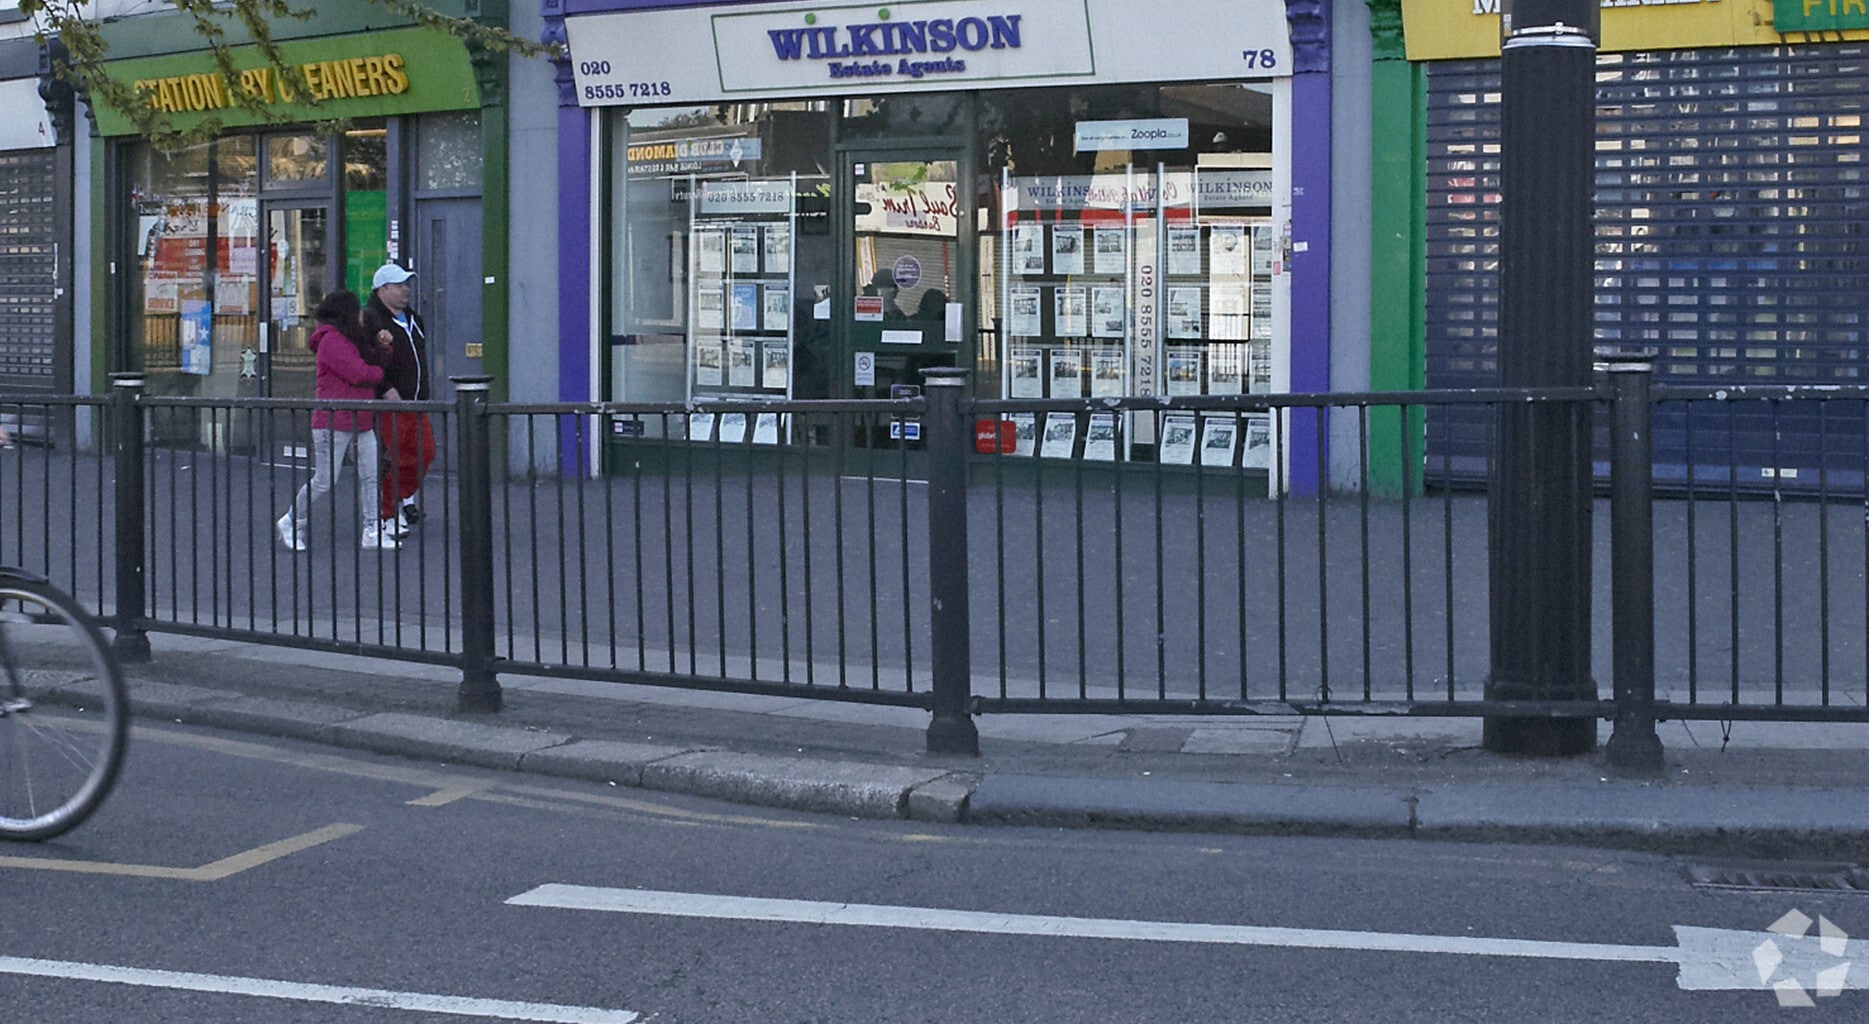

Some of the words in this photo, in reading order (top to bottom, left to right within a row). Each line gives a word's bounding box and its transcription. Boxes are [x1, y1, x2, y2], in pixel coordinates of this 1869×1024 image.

[767, 14, 1022, 61] WILKINSON
[580, 60, 611, 76] 020
[828, 60, 892, 78] Estate
[897, 56, 966, 78] Agents
[1242, 48, 1277, 70] 78
[275, 53, 409, 104] CEANERS
[584, 83, 625, 100] 8555
[629, 81, 672, 98] 7218
[38, 121, 46, 137] 4
[1131, 128, 1168, 141] Zoopla
[707, 192, 728, 203] 020
[730, 192, 756, 203] 8555
[759, 191, 785, 202] 7218
[1140, 264, 1153, 299] 020
[1140, 304, 1153, 349] 8555
[1139, 355, 1152, 396] 7218
